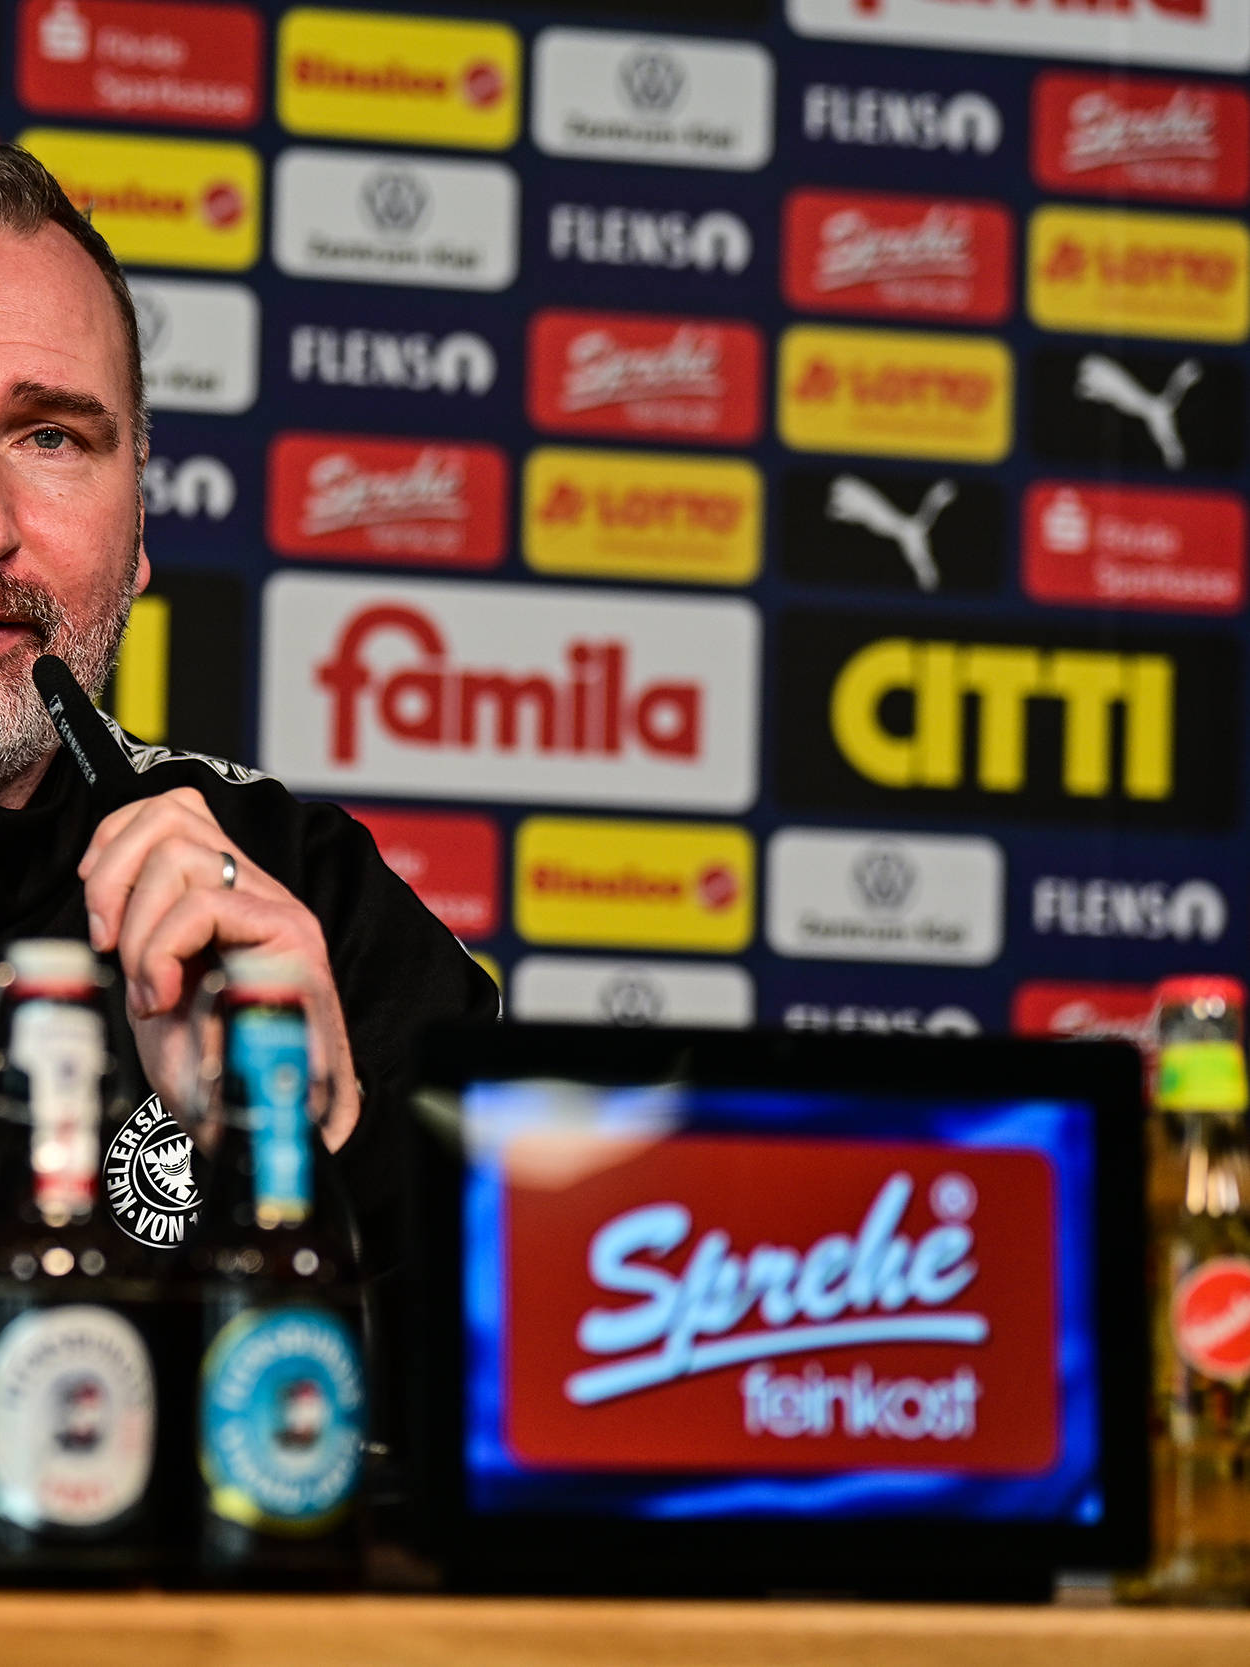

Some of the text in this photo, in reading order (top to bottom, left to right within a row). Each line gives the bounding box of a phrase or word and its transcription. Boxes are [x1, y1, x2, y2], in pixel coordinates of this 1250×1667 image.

[313, 601, 705, 768] famila
[829, 635, 1175, 802] CITTI
[106, 1128, 143, 1216] KIELER
[134, 1207, 185, 1242] VON
[743, 1363, 980, 1440] feinkost
